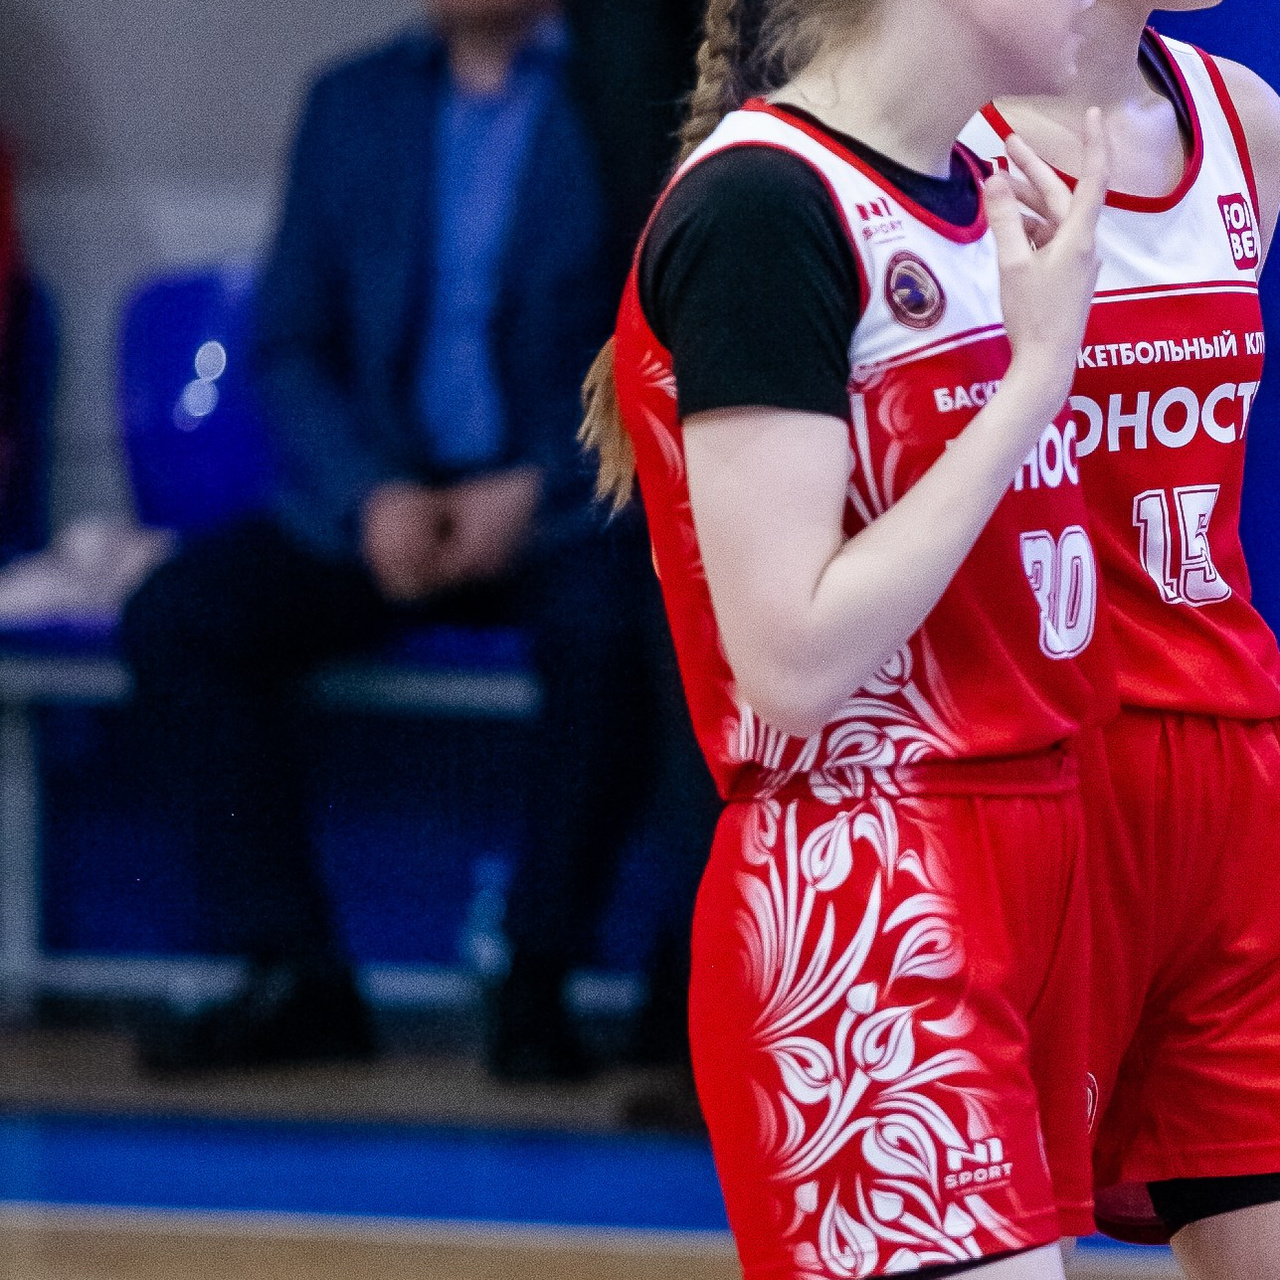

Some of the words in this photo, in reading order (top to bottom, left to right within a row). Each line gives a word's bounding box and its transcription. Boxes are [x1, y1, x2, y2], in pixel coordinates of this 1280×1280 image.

[1075, 330, 1238, 369] КЕТБОЛЬНЫЙ
[1244, 331, 1266, 355] КЛ
[1068, 381, 1261, 458] НОСТ
[1132, 483, 1232, 607] 15
[944, 1162, 1014, 1190] SPORT
